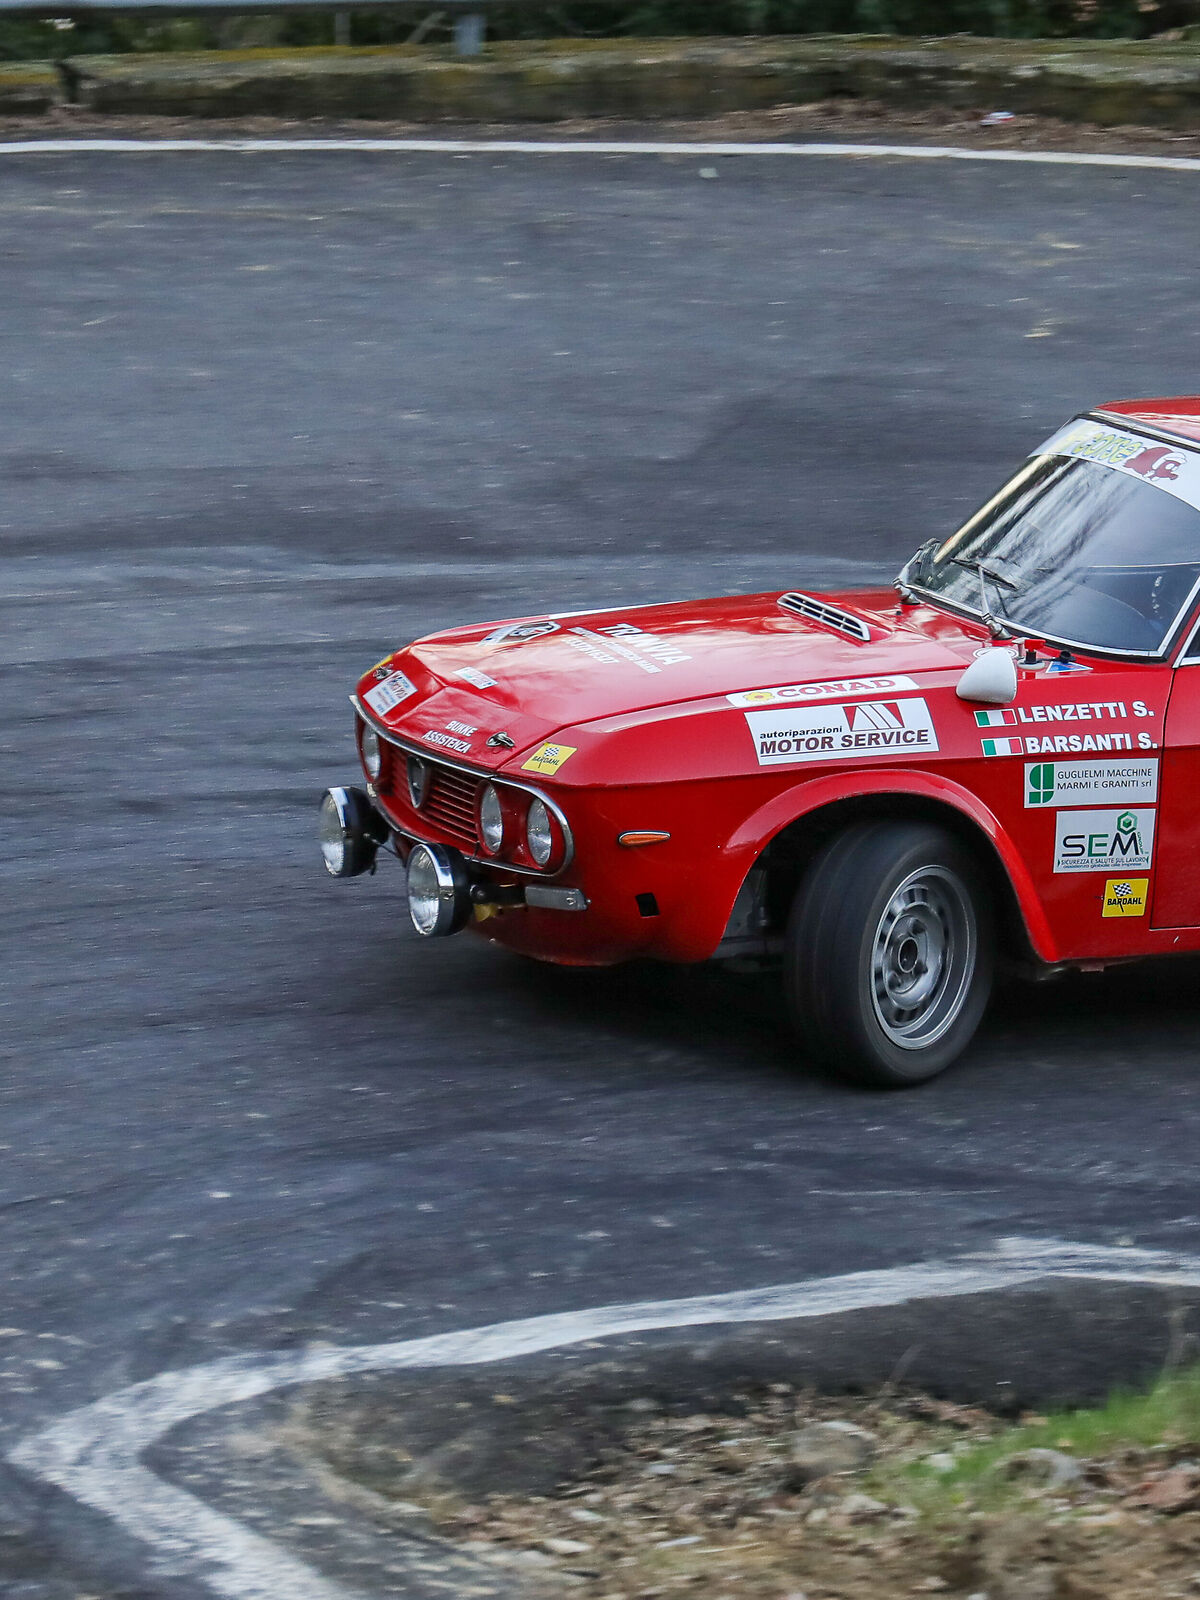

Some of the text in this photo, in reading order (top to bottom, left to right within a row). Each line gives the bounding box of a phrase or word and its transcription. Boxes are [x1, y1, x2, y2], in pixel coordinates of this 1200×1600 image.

[776, 678, 897, 699] CONAD
[1017, 700, 1155, 723] LENZETTI S.
[421, 730, 472, 754] ASSISTENZA
[759, 726, 843, 739] autoriparazioni
[759, 728, 929, 755] MOTOR SERVICE
[1025, 732, 1159, 755] BARSANTI S.
[1057, 768, 1152, 780] GUGLIELMI MACCHINE
[1057, 779, 1152, 790] MARMI E GRANITI srl
[1061, 832, 1140, 858] SEM
[1107, 897, 1143, 906] BARDAHL
